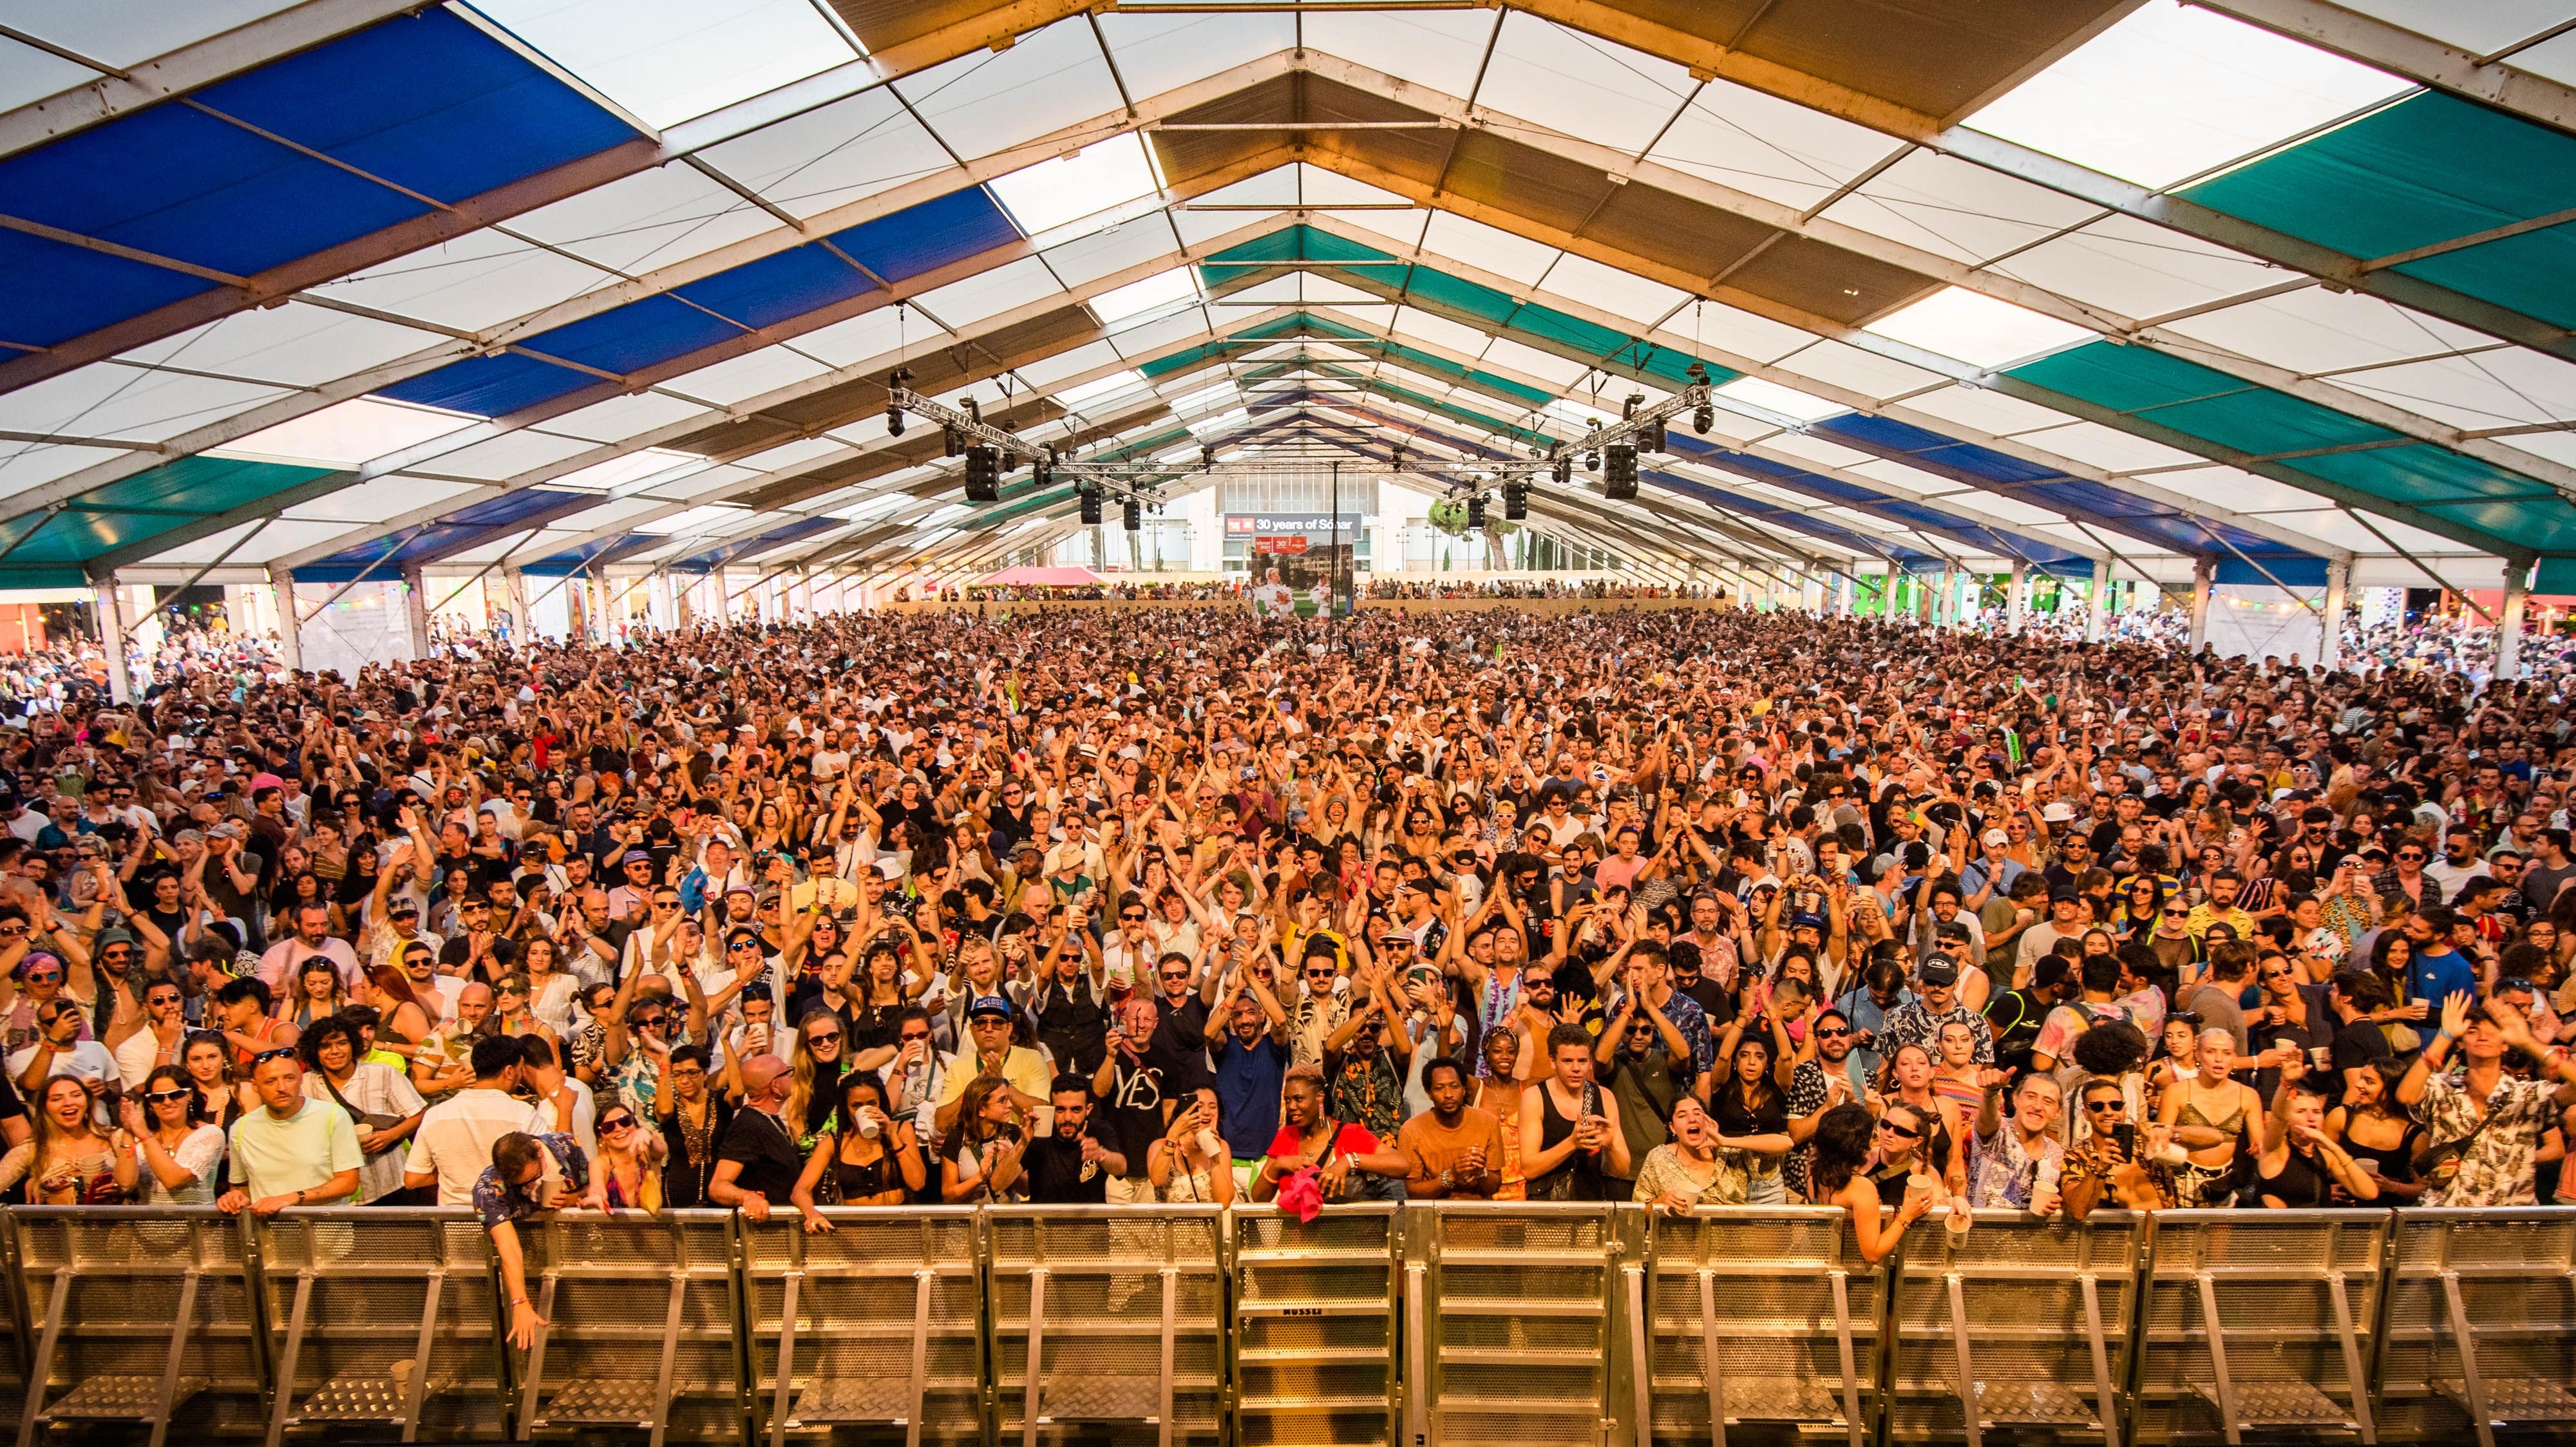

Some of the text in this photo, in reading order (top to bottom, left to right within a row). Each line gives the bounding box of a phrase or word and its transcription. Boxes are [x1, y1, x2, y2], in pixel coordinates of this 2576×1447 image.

[1256, 519, 1271, 529] 30
[1272, 519, 1303, 531] years
[1305, 519, 1318, 530] of
[987, 998, 1003, 1007] LOST
[1115, 1064, 1164, 1110] YES
